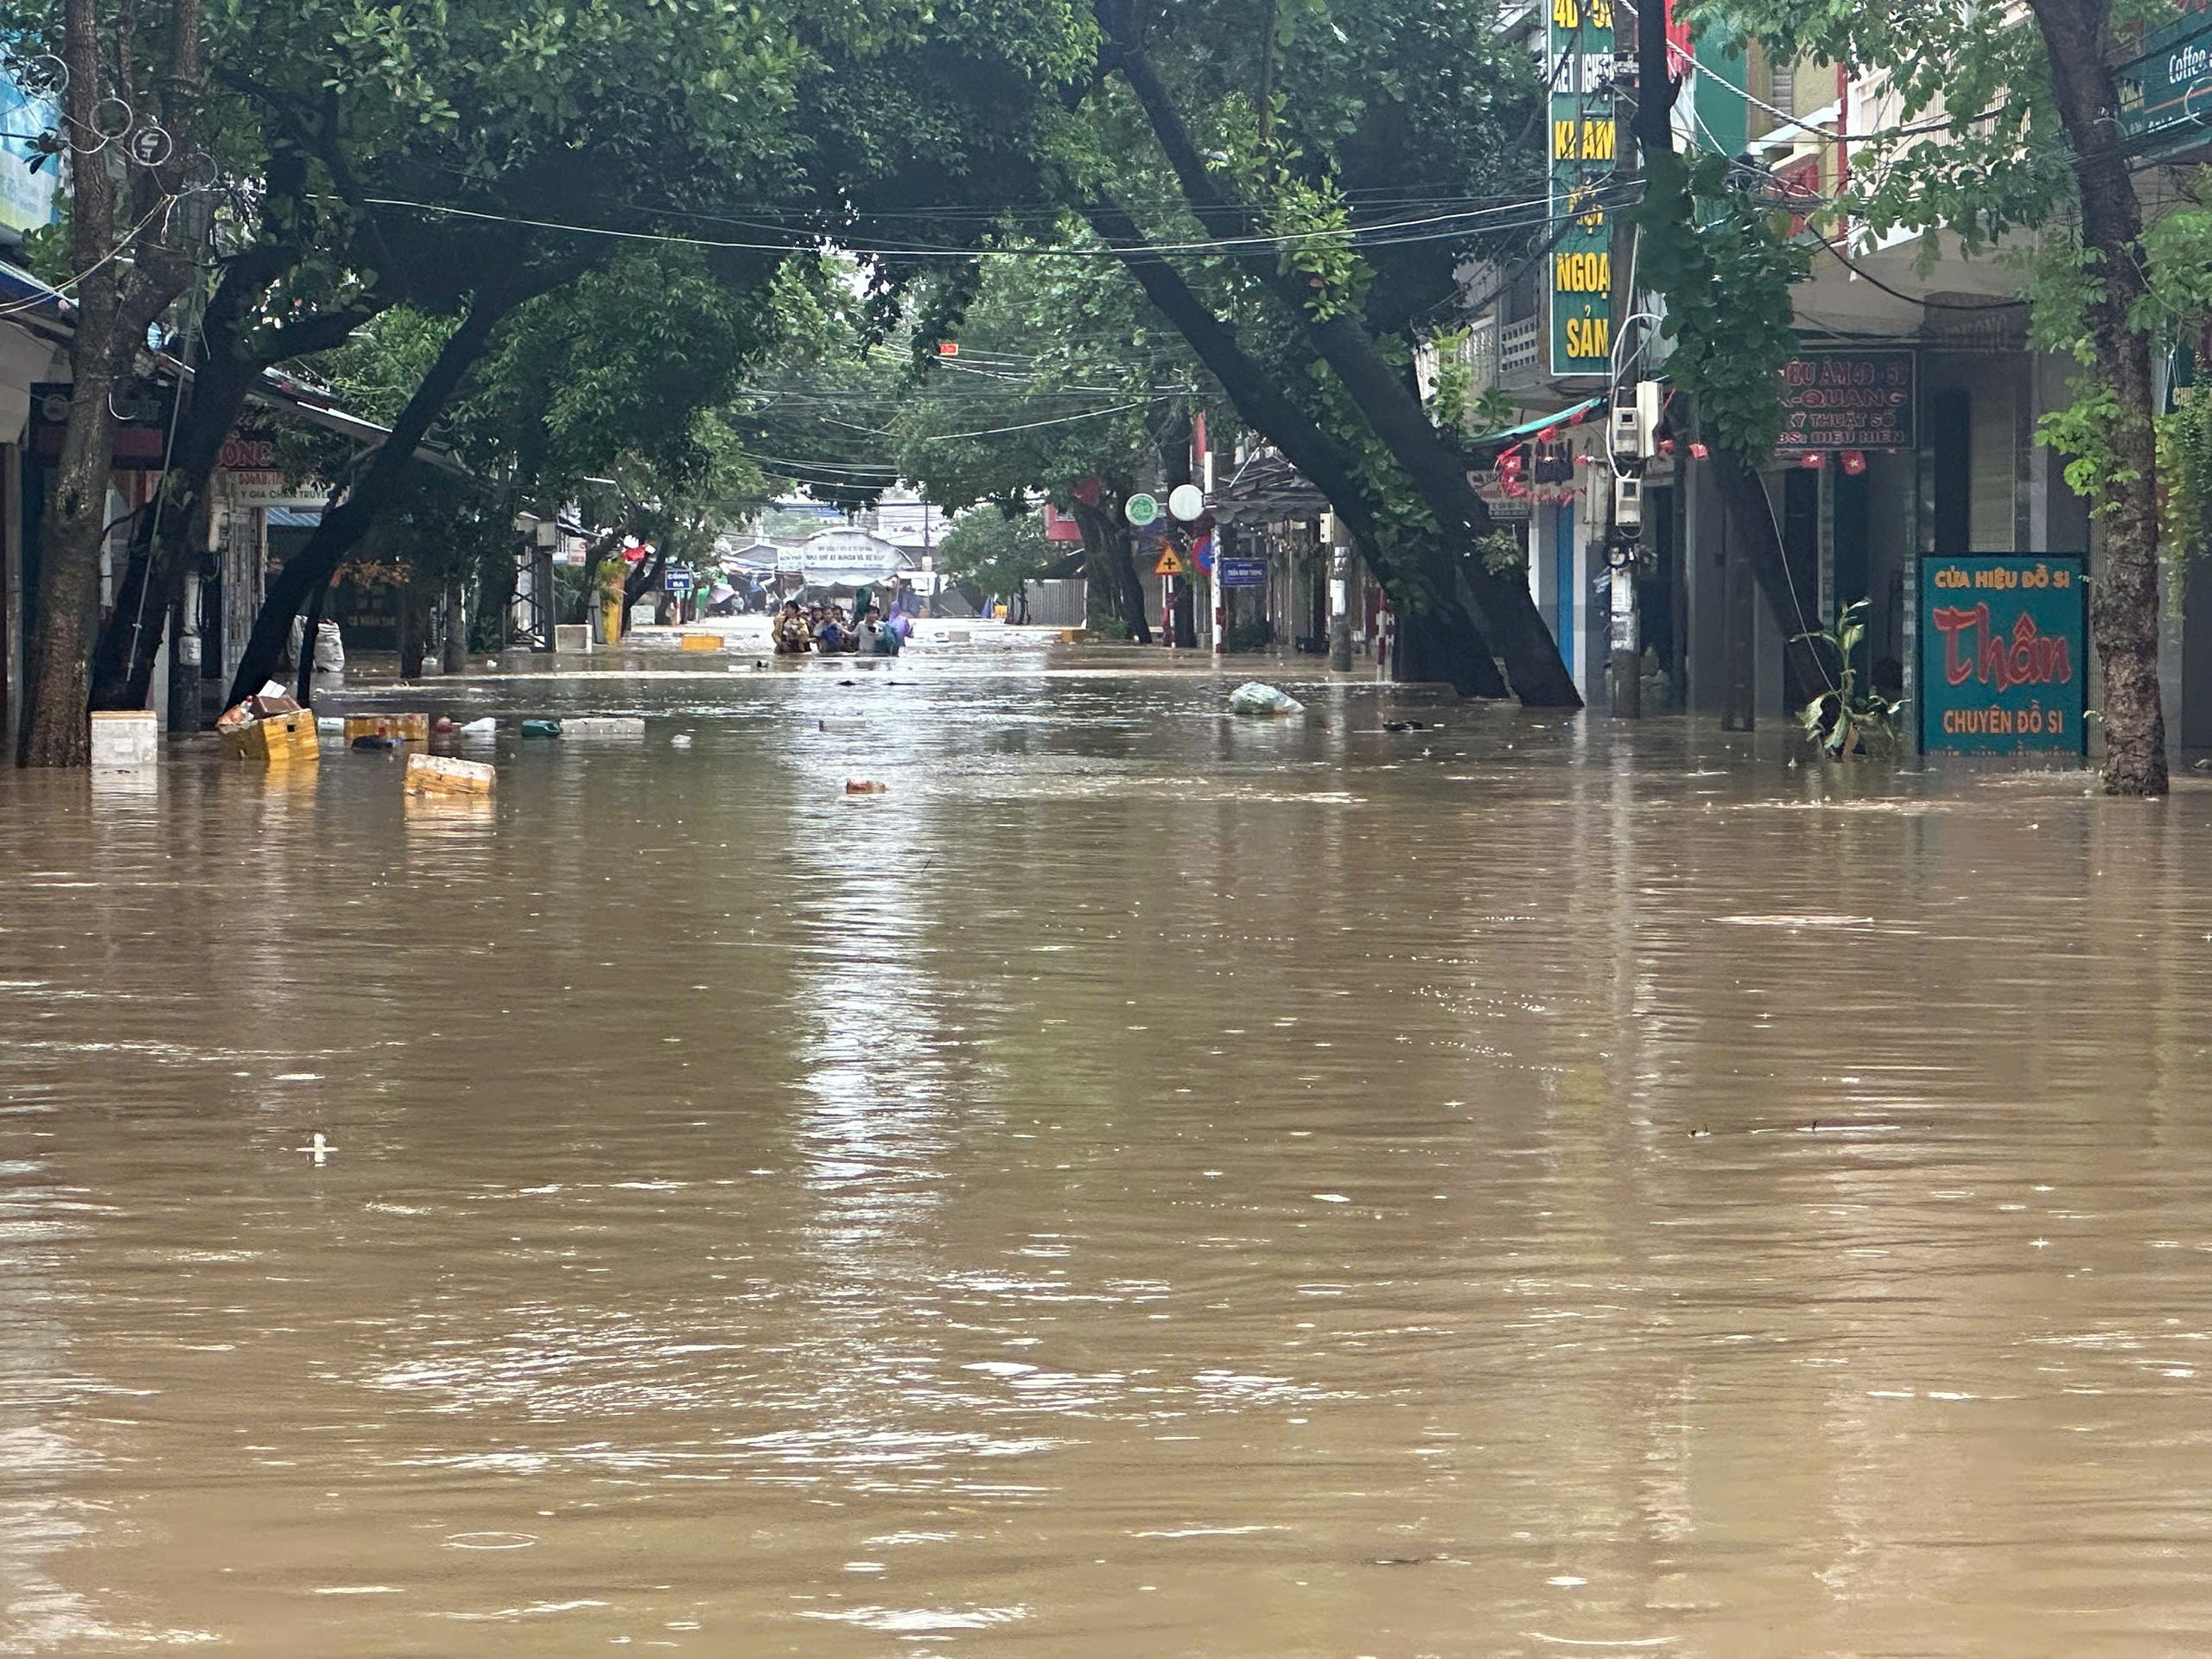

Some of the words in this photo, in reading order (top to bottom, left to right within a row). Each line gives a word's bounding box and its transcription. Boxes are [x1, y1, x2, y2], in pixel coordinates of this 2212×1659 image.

[1556, 252, 1611, 299] NGOẠ
[1566, 304, 1609, 358] SẢN
[1935, 565, 1971, 588] CỬA
[1974, 567, 2018, 589] HIỆU
[2053, 570, 2070, 588] SI
[1933, 601, 2071, 693] Thân
[1943, 704, 2012, 734] CHUYÊN
[2017, 699, 2042, 734] ĐỒ
[2047, 710, 2063, 734] SI
